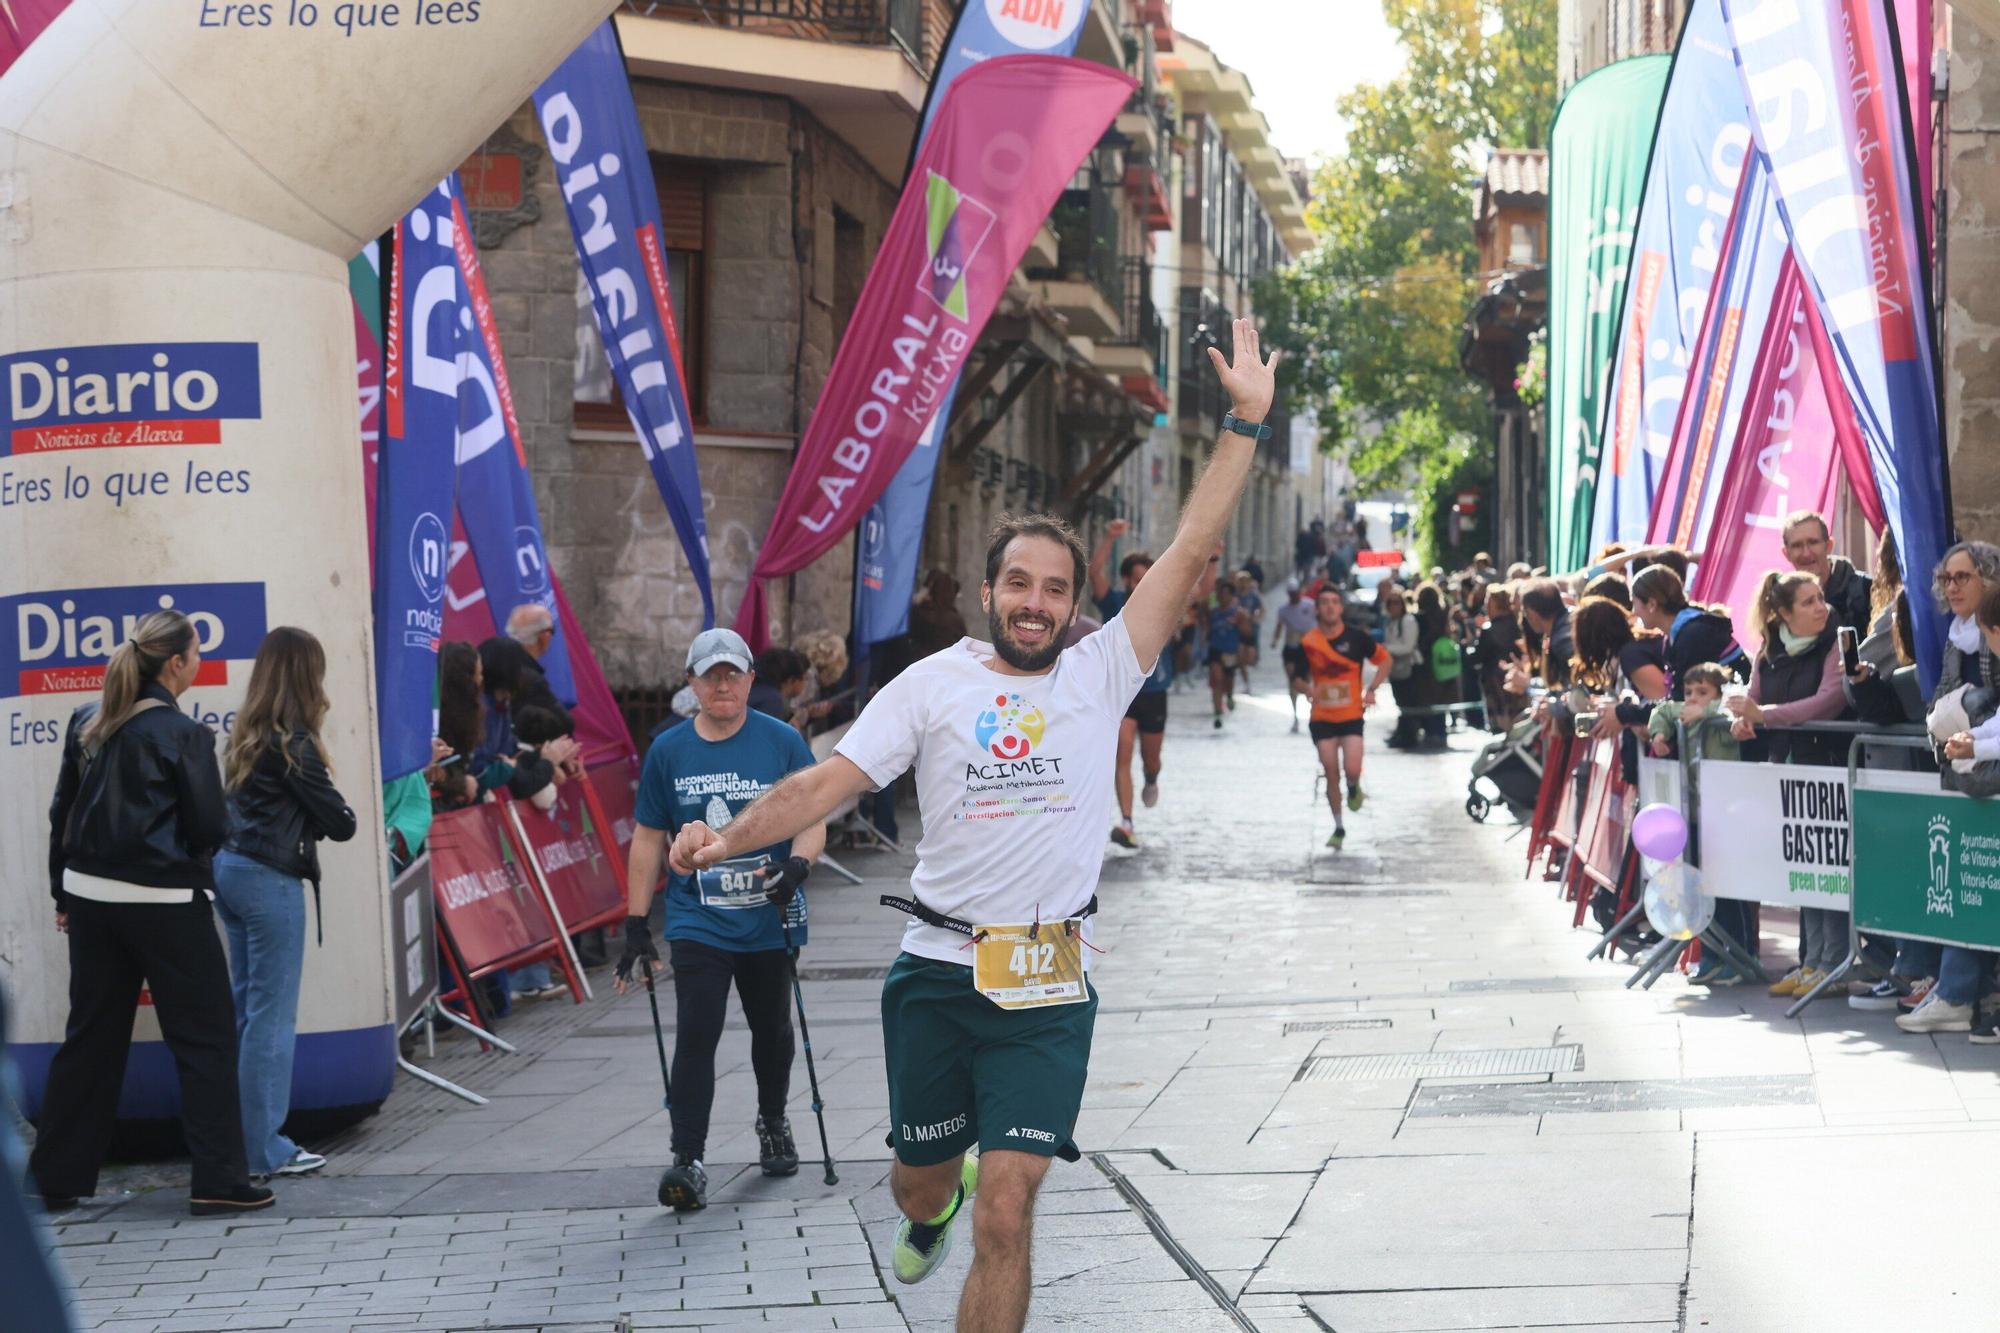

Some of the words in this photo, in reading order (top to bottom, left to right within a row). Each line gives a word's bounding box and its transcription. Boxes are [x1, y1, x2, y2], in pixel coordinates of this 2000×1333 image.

[199, 2, 273, 27] Eres
[289, 0, 318, 26] lo
[333, 2, 399, 37] que
[415, 0, 482, 25] lees
[1000, 0, 1064, 31] ADN
[10, 352, 219, 422] Diario
[903, 326, 969, 425] kutxa
[797, 312, 938, 534] LABORAL
[1743, 288, 1806, 530] LABO
[34, 429, 97, 450] Noticias
[102, 426, 121, 445] de
[126, 420, 184, 444] Álava
[2, 472, 51, 506] Eres
[64, 465, 90, 499] lo
[104, 471, 169, 507] que
[185, 460, 251, 495] lees
[41, 671, 105, 692] Noticias
[10, 712, 58, 746] Eres
[685, 772, 739, 785] CONQUISTA
[966, 757, 1062, 781] ACIMET
[687, 779, 760, 796] ALMENDRA
[1780, 779, 1848, 822] VITORIA
[1782, 823, 1849, 867] GASTEIZ
[1960, 850, 1970, 866] de
[720, 871, 754, 892] 847
[1788, 870, 1816, 892] green
[1960, 890, 1982, 906] Udala
[1008, 943, 1055, 977] 412
[902, 1123, 914, 1142] D.
[915, 1113, 967, 1142] MATEOS
[1020, 1127, 1057, 1143] TERREX
